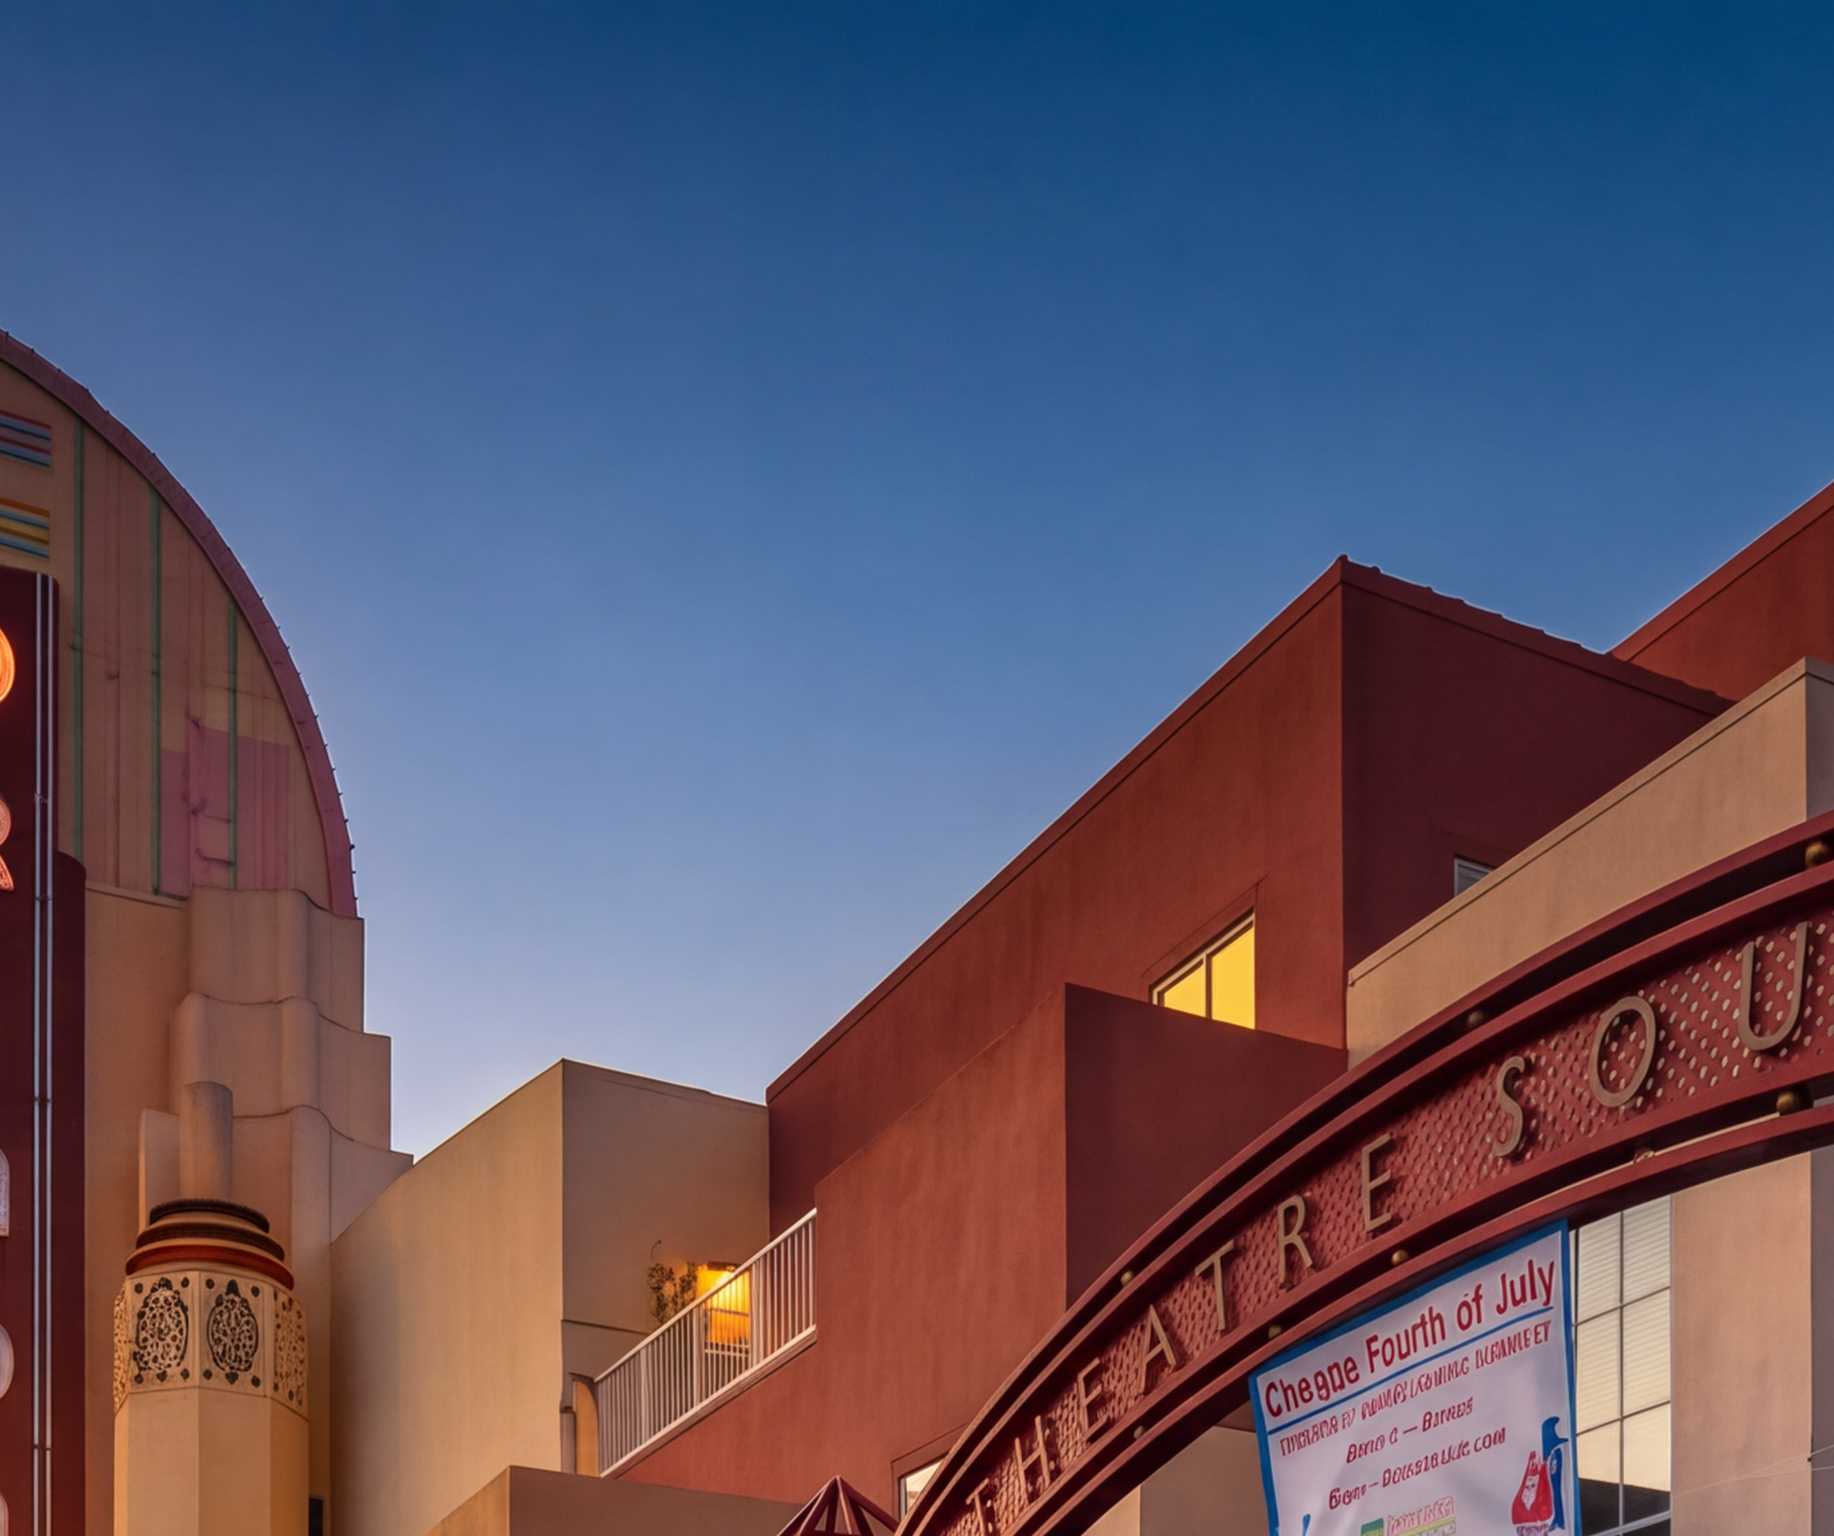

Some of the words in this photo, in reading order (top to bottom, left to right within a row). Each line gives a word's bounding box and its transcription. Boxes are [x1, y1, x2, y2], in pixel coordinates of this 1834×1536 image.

[1366, 1305, 1446, 1374] Fourth
[1456, 1283, 1484, 1331] of
[1496, 1258, 1555, 1315] July
